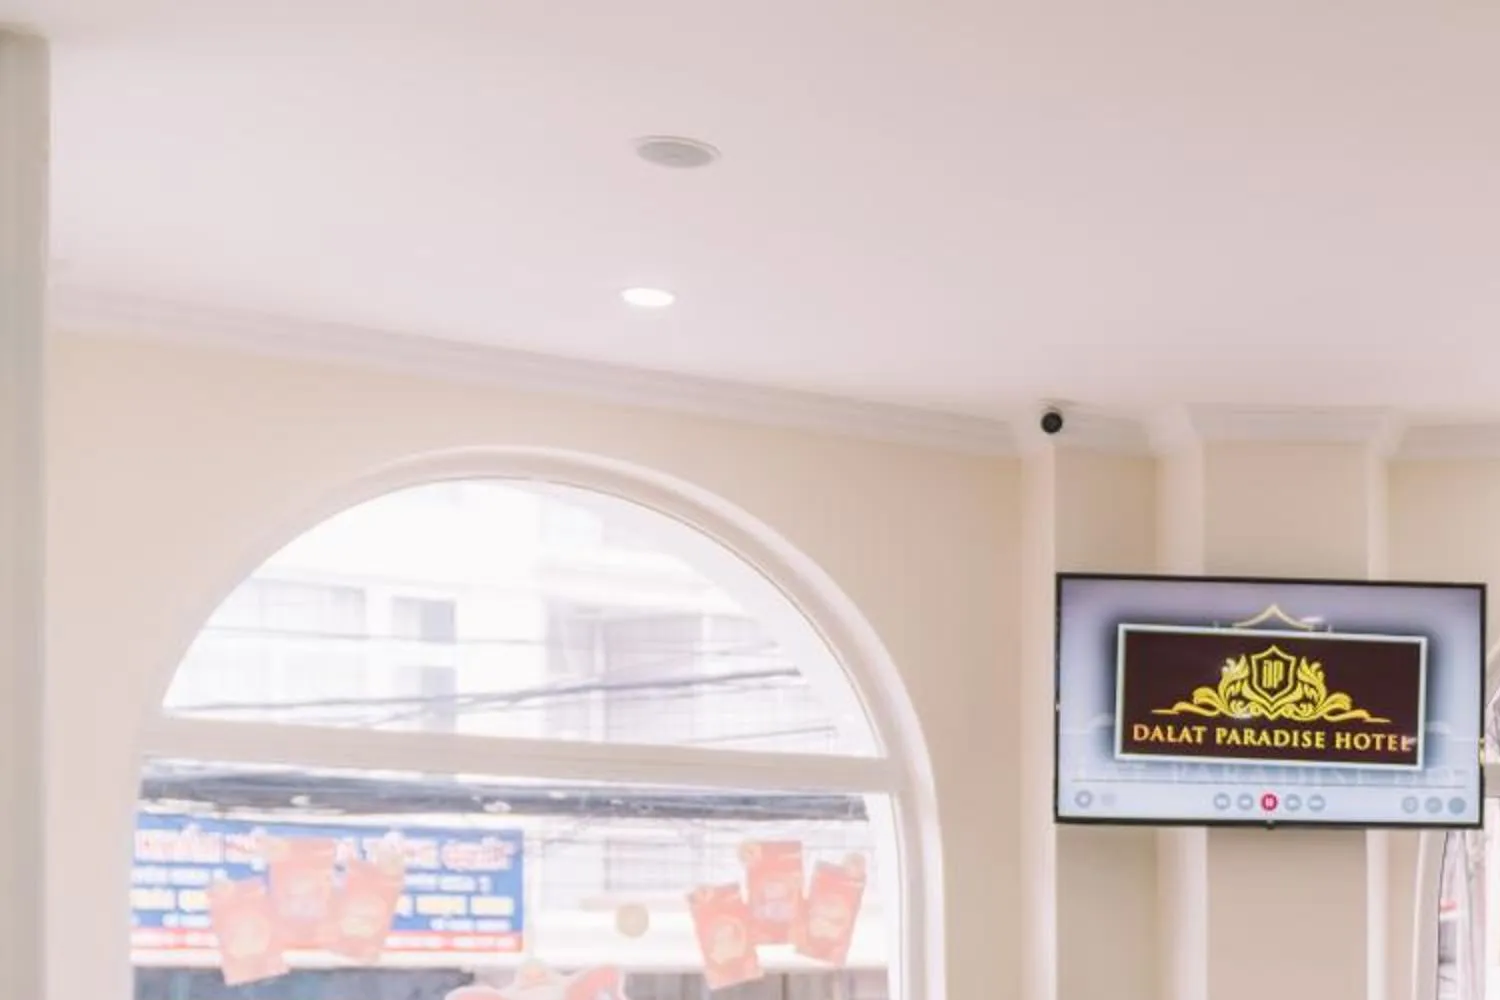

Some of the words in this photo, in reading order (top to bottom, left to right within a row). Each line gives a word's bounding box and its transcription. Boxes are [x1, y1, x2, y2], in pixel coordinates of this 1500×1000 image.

[1132, 723, 1207, 745] DALAT
[1215, 727, 1326, 749] PARADISE
[1335, 732, 1413, 753] HOTEL
